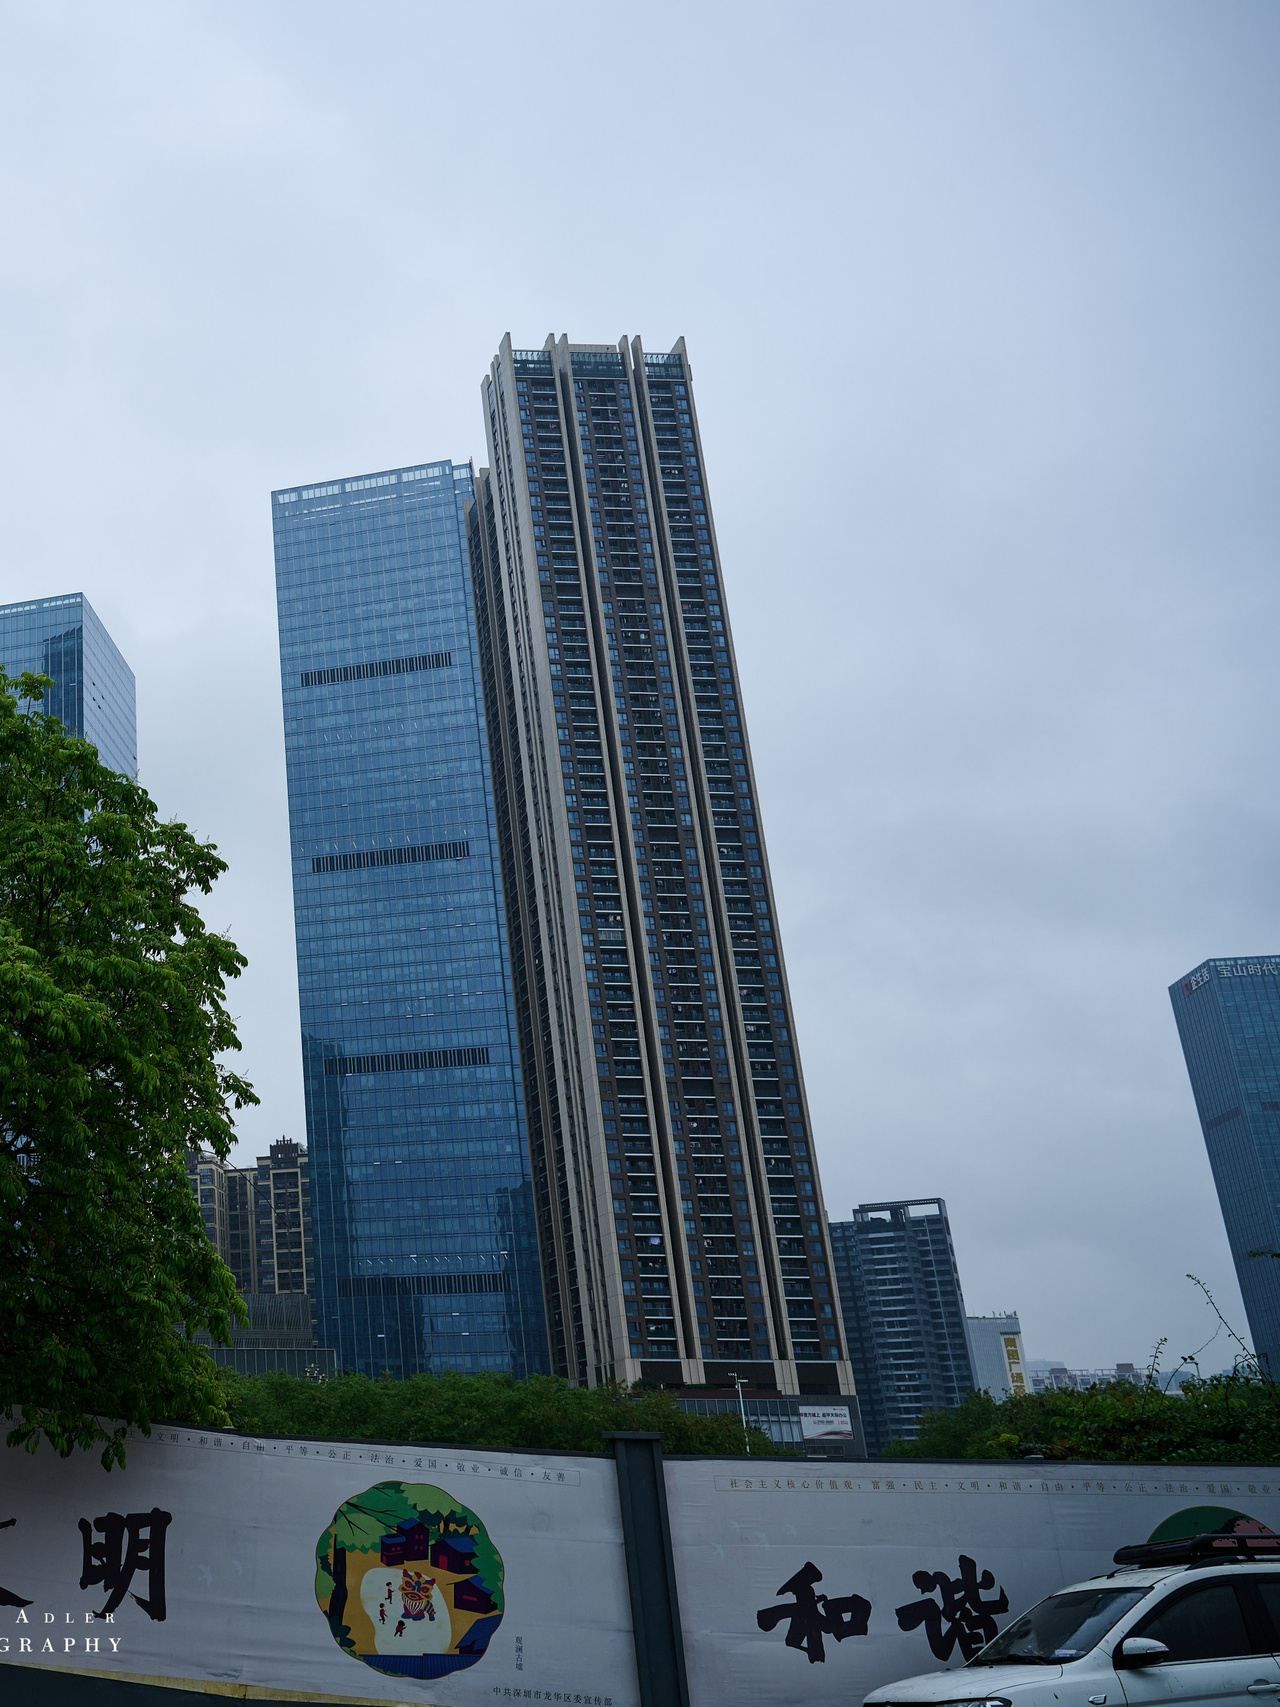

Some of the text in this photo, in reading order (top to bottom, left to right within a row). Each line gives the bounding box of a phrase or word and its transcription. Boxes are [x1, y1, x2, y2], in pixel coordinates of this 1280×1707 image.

[1217, 963, 1280, 978] 宝山时代
[757, 1555, 1009, 1664] 和谐
[492, 1686, 613, 1706] 中共深圳市龙华区委宣传部
